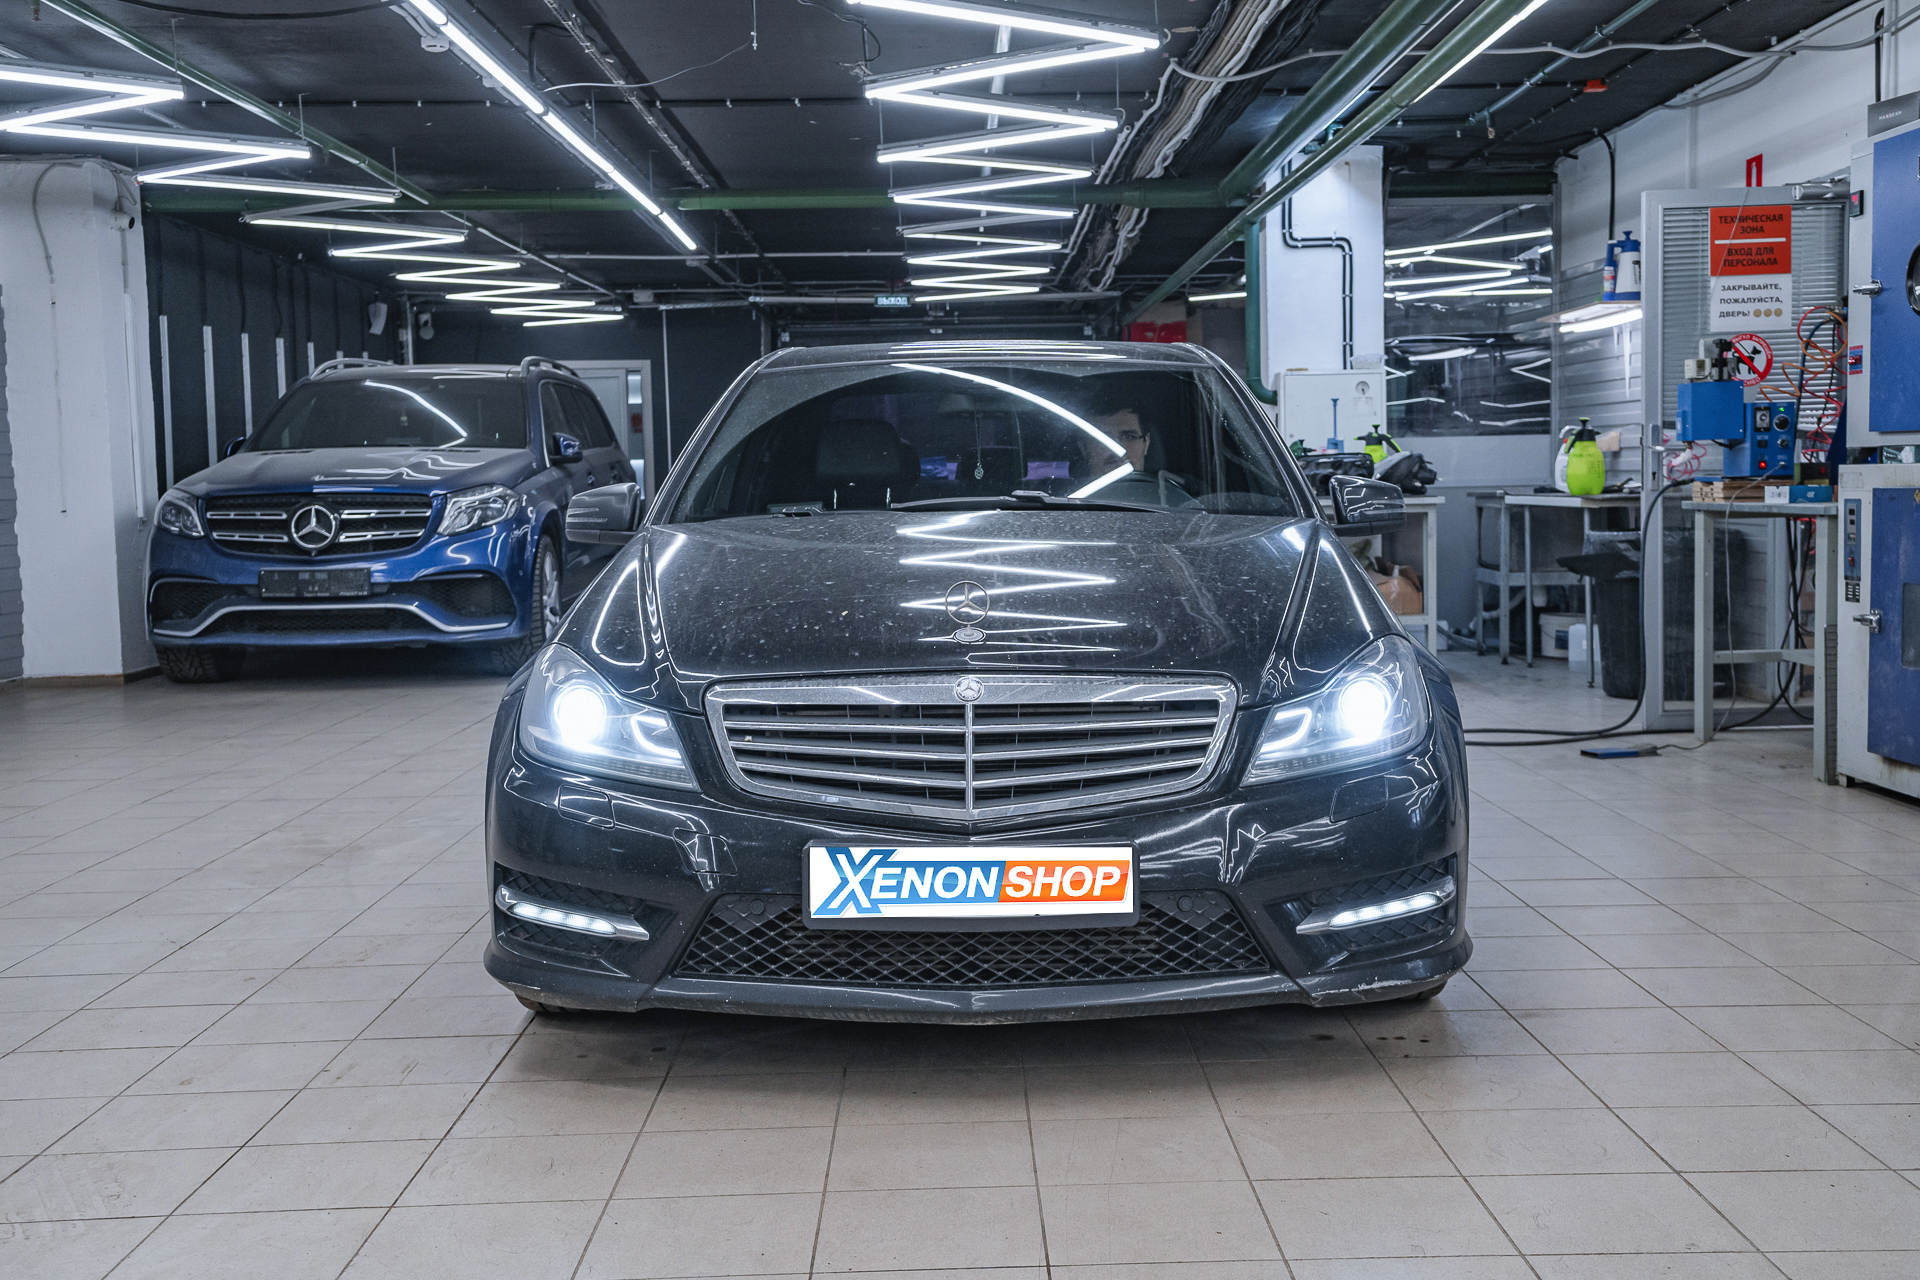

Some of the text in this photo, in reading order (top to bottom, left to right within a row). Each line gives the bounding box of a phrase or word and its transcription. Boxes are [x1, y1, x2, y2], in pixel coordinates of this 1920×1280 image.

[1718, 213, 1784, 225] ТЕХНИЧЕСКАЯ
[1740, 225, 1766, 234] ЗОНА
[1727, 246, 1775, 257] ВХОД ДЛЯ
[1722, 257, 1778, 268] ПЕРСОНАЛА
[1721, 283, 1782, 292] ЗАКРЫВАЙТЕ,
[1718, 310, 1751, 319] ДВЕРЬ!
